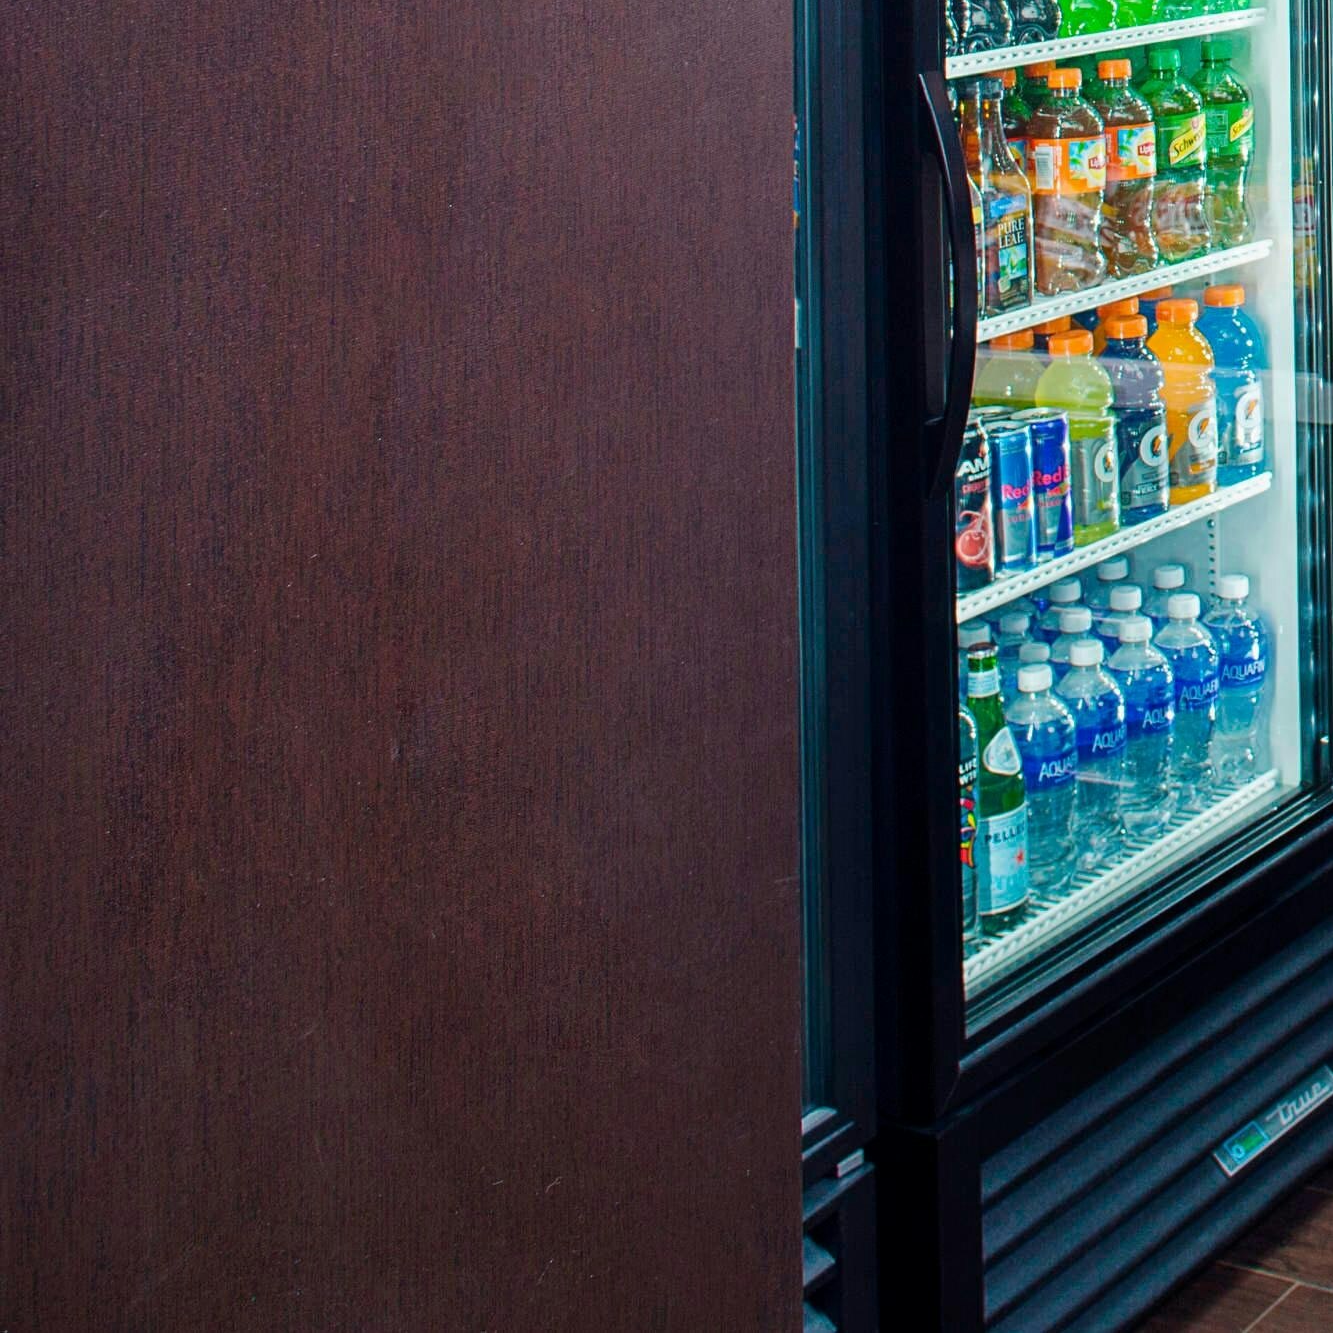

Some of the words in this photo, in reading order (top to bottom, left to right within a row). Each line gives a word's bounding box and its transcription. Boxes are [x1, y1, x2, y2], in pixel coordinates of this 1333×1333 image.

[998, 218, 1026, 236] PURE
[998, 232, 1025, 248] LEAF
[1033, 470, 1062, 487] Red
[1221, 660, 1265, 681] AQUAFIN
